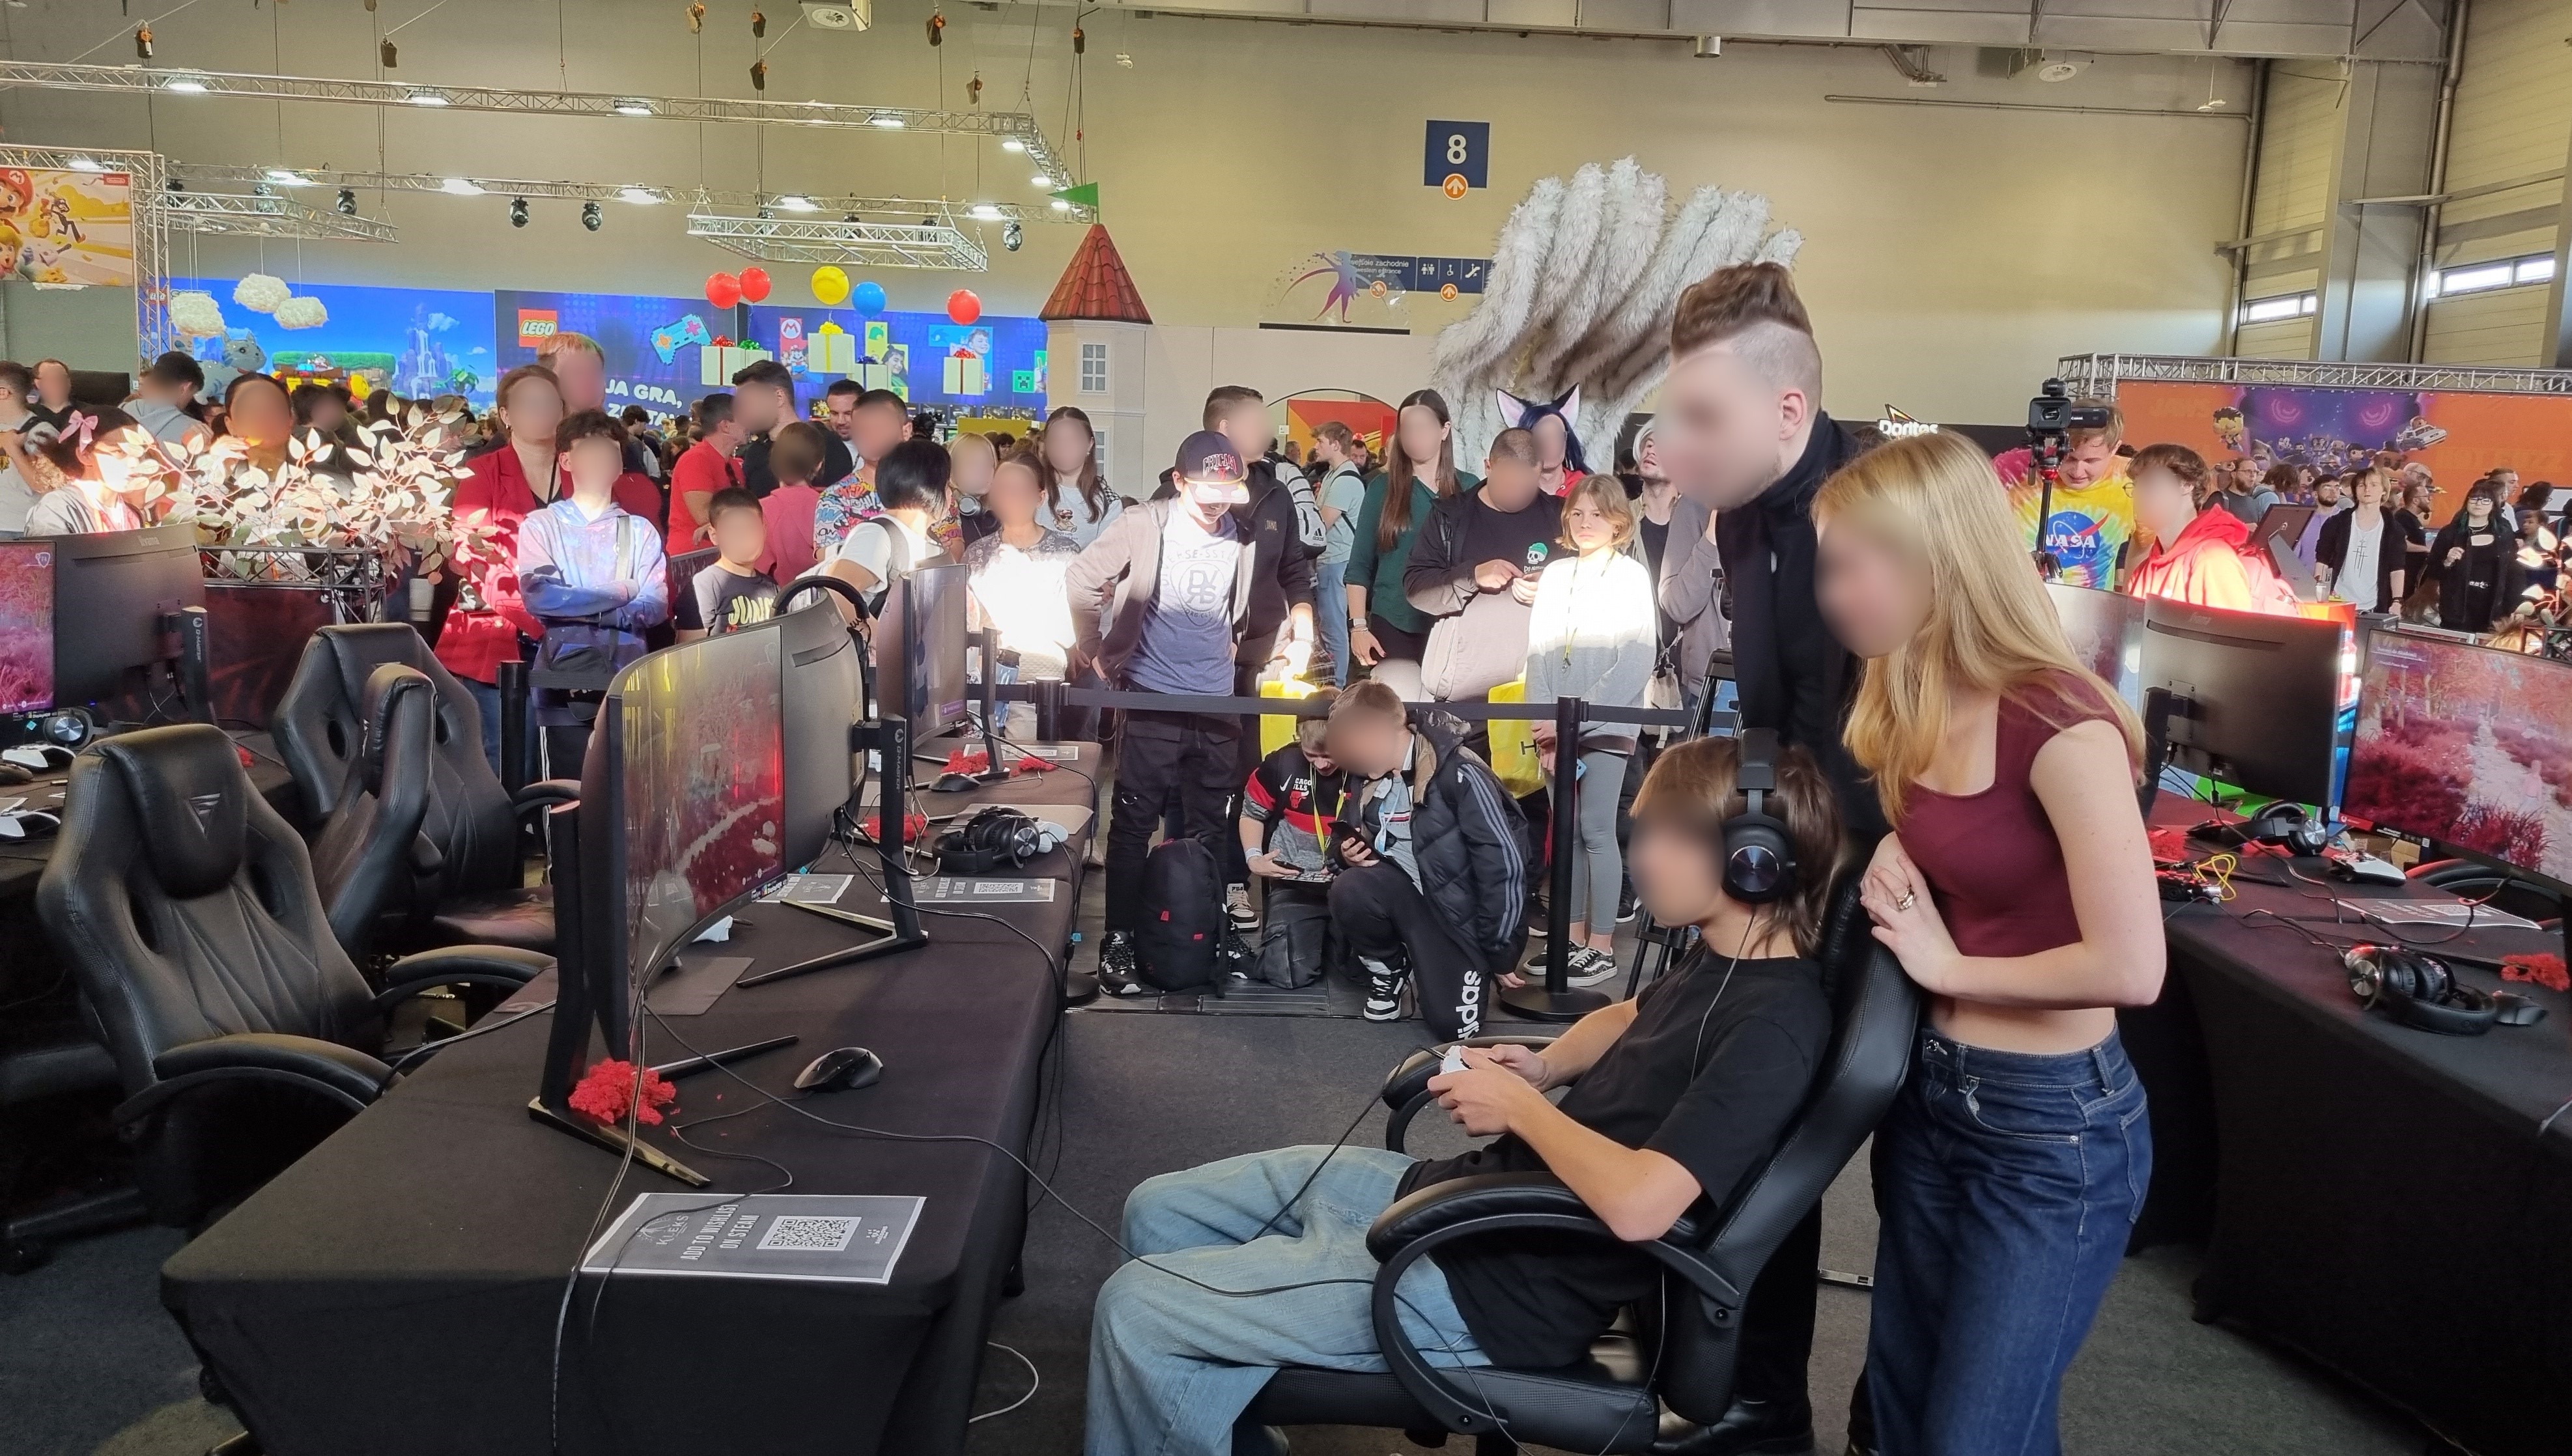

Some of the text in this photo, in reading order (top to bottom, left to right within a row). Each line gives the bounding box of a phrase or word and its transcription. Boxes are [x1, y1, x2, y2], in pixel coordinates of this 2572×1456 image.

[1447, 134, 1467, 165] 8
[521, 321, 556, 337] LEGO
[634, 384, 683, 409] GRA,
[1879, 419, 1938, 437] Doritos
[2046, 535, 2097, 548] NASA
[1456, 970, 1482, 1040] didas
[656, 1215, 689, 1245] KLEKS
[681, 1205, 740, 1260] ADD TO WISHLIST
[719, 1215, 760, 1249] ON STEAM
